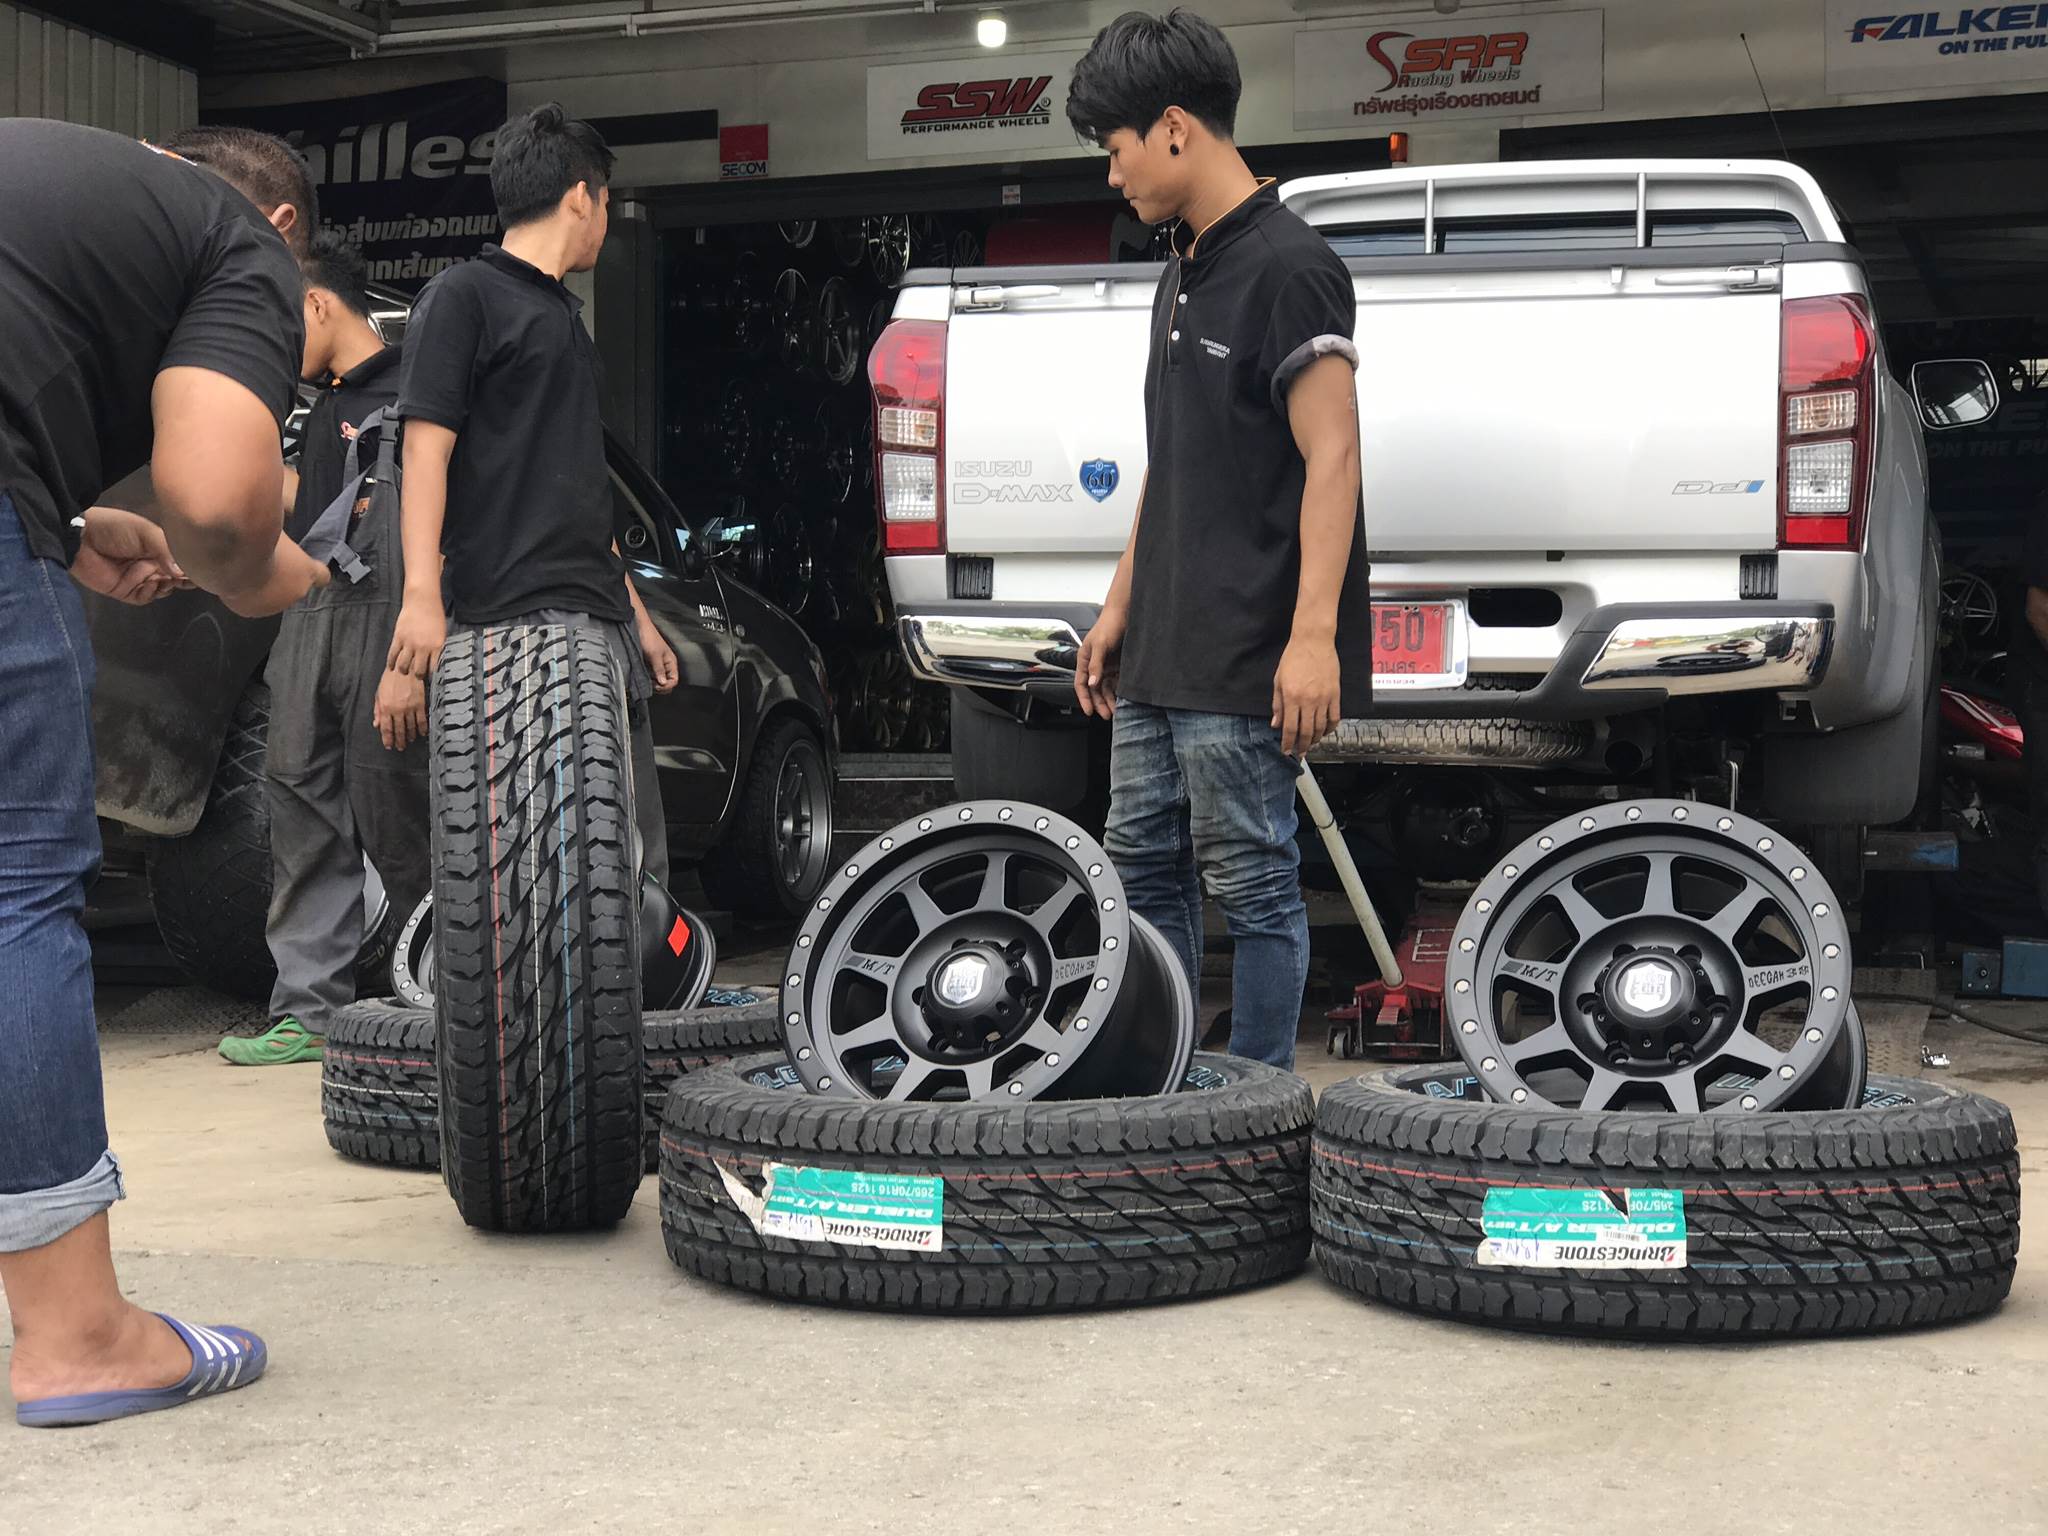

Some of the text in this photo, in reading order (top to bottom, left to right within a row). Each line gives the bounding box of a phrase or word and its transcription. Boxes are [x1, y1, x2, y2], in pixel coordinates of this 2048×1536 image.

[1401, 32, 1529, 73] SRR
[1938, 40, 1970, 55] ON
[1973, 37, 2008, 53] THE
[1397, 67, 1521, 88] Racing Wheels
[901, 75, 1053, 122] SSW
[902, 116, 1051, 135] PERFORMANCE WHEELS
[722, 161, 766, 177] SECOM
[954, 460, 1032, 478] ISUZU
[953, 482, 1074, 505] D-MAX
[851, 1182, 877, 1195] 112S
[793, 1196, 836, 1211] A/T
[837, 1201, 934, 1219] DUELER
[825, 1221, 933, 1247] BRIDGESTONE
[1514, 1221, 1564, 1233] A/T
[1555, 1245, 1676, 1263] BRIDGESTONE
